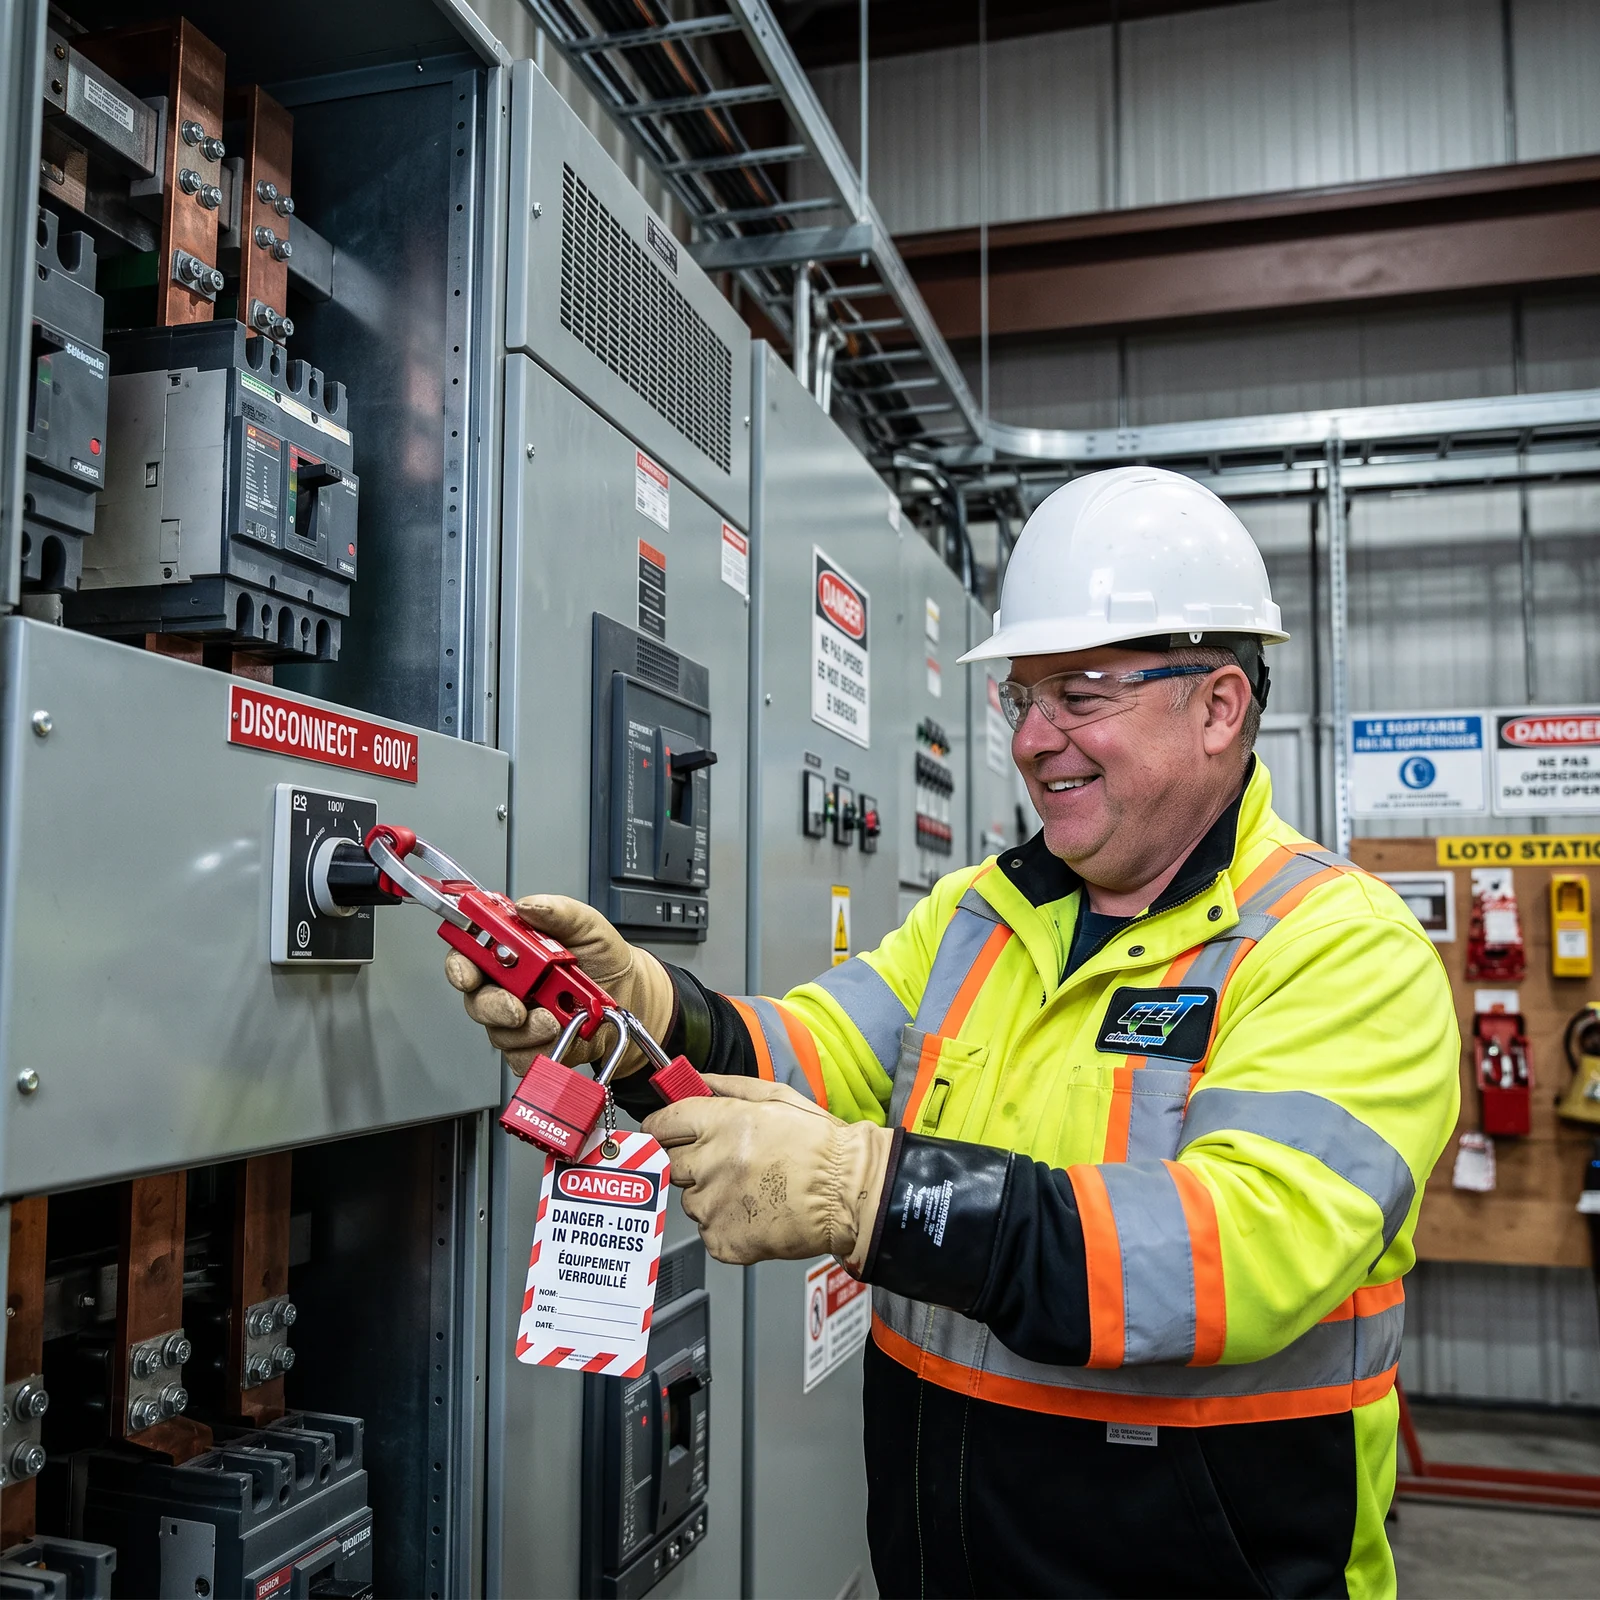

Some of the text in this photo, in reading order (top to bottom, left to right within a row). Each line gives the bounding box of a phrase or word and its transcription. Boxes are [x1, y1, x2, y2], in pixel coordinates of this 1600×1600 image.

[240, 698, 359, 758] DISCONNECT
[373, 733, 412, 771] 600V
[1514, 720, 1600, 742] DANGE
[1528, 785, 1556, 797] NOT
[1447, 842, 1512, 861] LOTO
[515, 1105, 571, 1141] Master
[566, 1174, 646, 1199] DANGER
[551, 1208, 605, 1228] DANGER
[617, 1216, 650, 1234] LOTO
[552, 1227, 644, 1252] IN PROGRESS
[558, 1249, 631, 1273] ÉQUIPEMENT
[559, 1268, 628, 1289] VERROUILLÉ
[538, 1288, 558, 1299] NOM:
[536, 1304, 557, 1314] DATE:
[534, 1320, 555, 1330] DATE:
